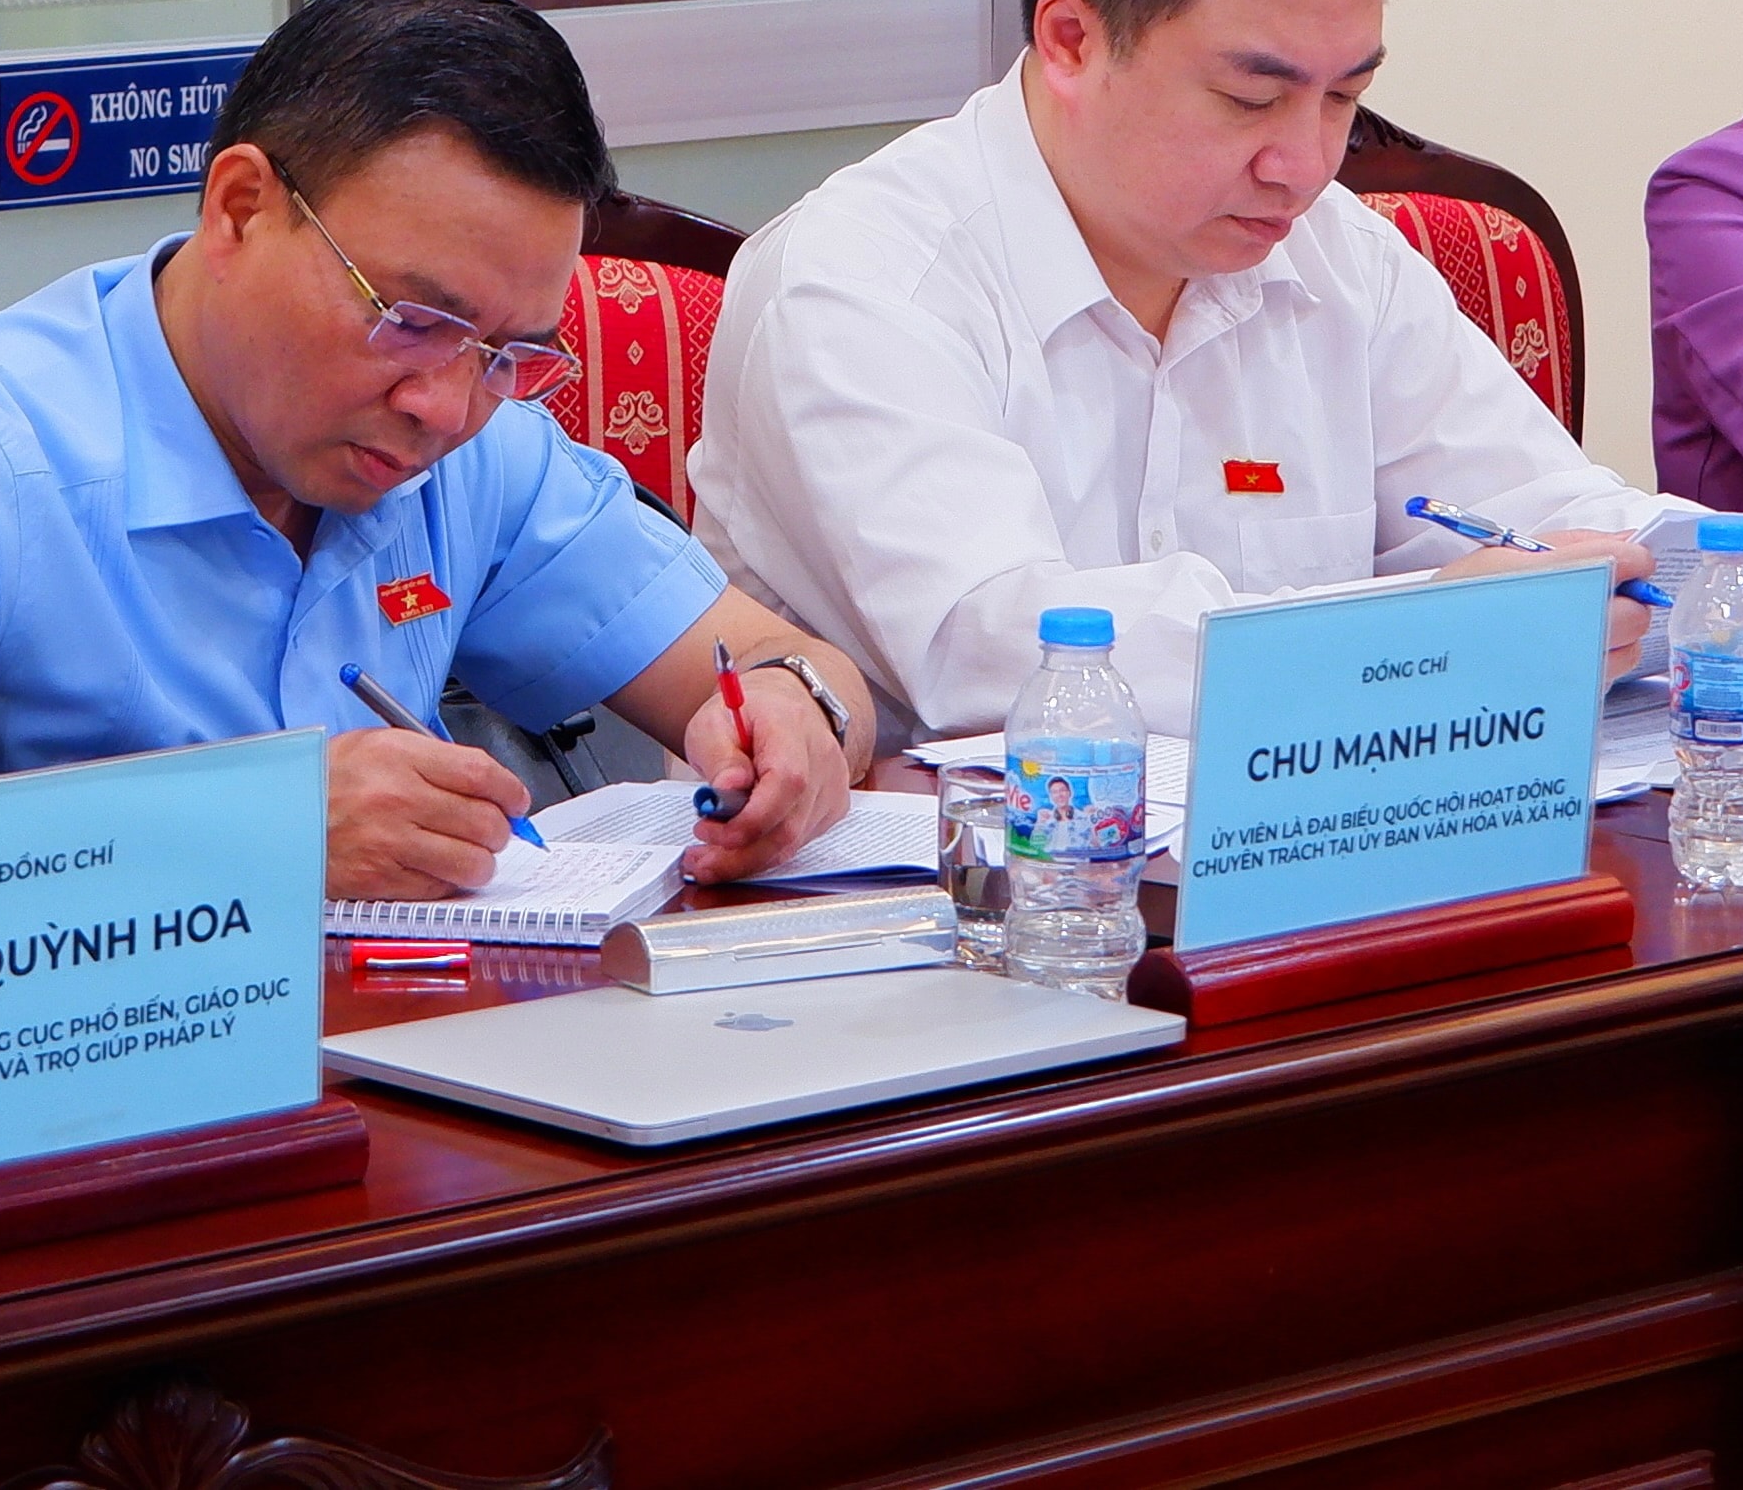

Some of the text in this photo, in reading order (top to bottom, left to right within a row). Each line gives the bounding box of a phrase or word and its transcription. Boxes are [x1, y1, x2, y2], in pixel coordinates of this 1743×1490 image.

[89, 76, 228, 124] KHÔNG HÚT
[129, 147, 161, 179] NO
[1362, 650, 1450, 684] ĐỒNG CHÍ
[1247, 739, 1322, 782] CHU
[1333, 722, 1437, 774] MẠNH
[1449, 705, 1545, 752] HÙNG
[1192, 796, 1582, 878] CHUYÊN TRÁCH TẠI ỦY BAN VĂN HÓA VÀ XÃ HỘI
[1211, 777, 1566, 851] ỦY VIÊN LÀ ĐẠI BIỂU QUỐC HỘI HOẠT ĐỘNG
[74, 839, 114, 870] CHÍ
[154, 898, 252, 951] HOA
[17, 1021, 64, 1049] CỤC
[70, 1002, 118, 1037] PHỔ
[124, 994, 180, 1027] BIẾN,
[185, 986, 239, 1015] GIÁO
[245, 977, 290, 1006] DỤC
[35, 1043, 80, 1073] TRỢ
[86, 1031, 138, 1063] GIÚP
[145, 1021, 205, 1052] PHÁP
[211, 1011, 236, 1039] LÝ
